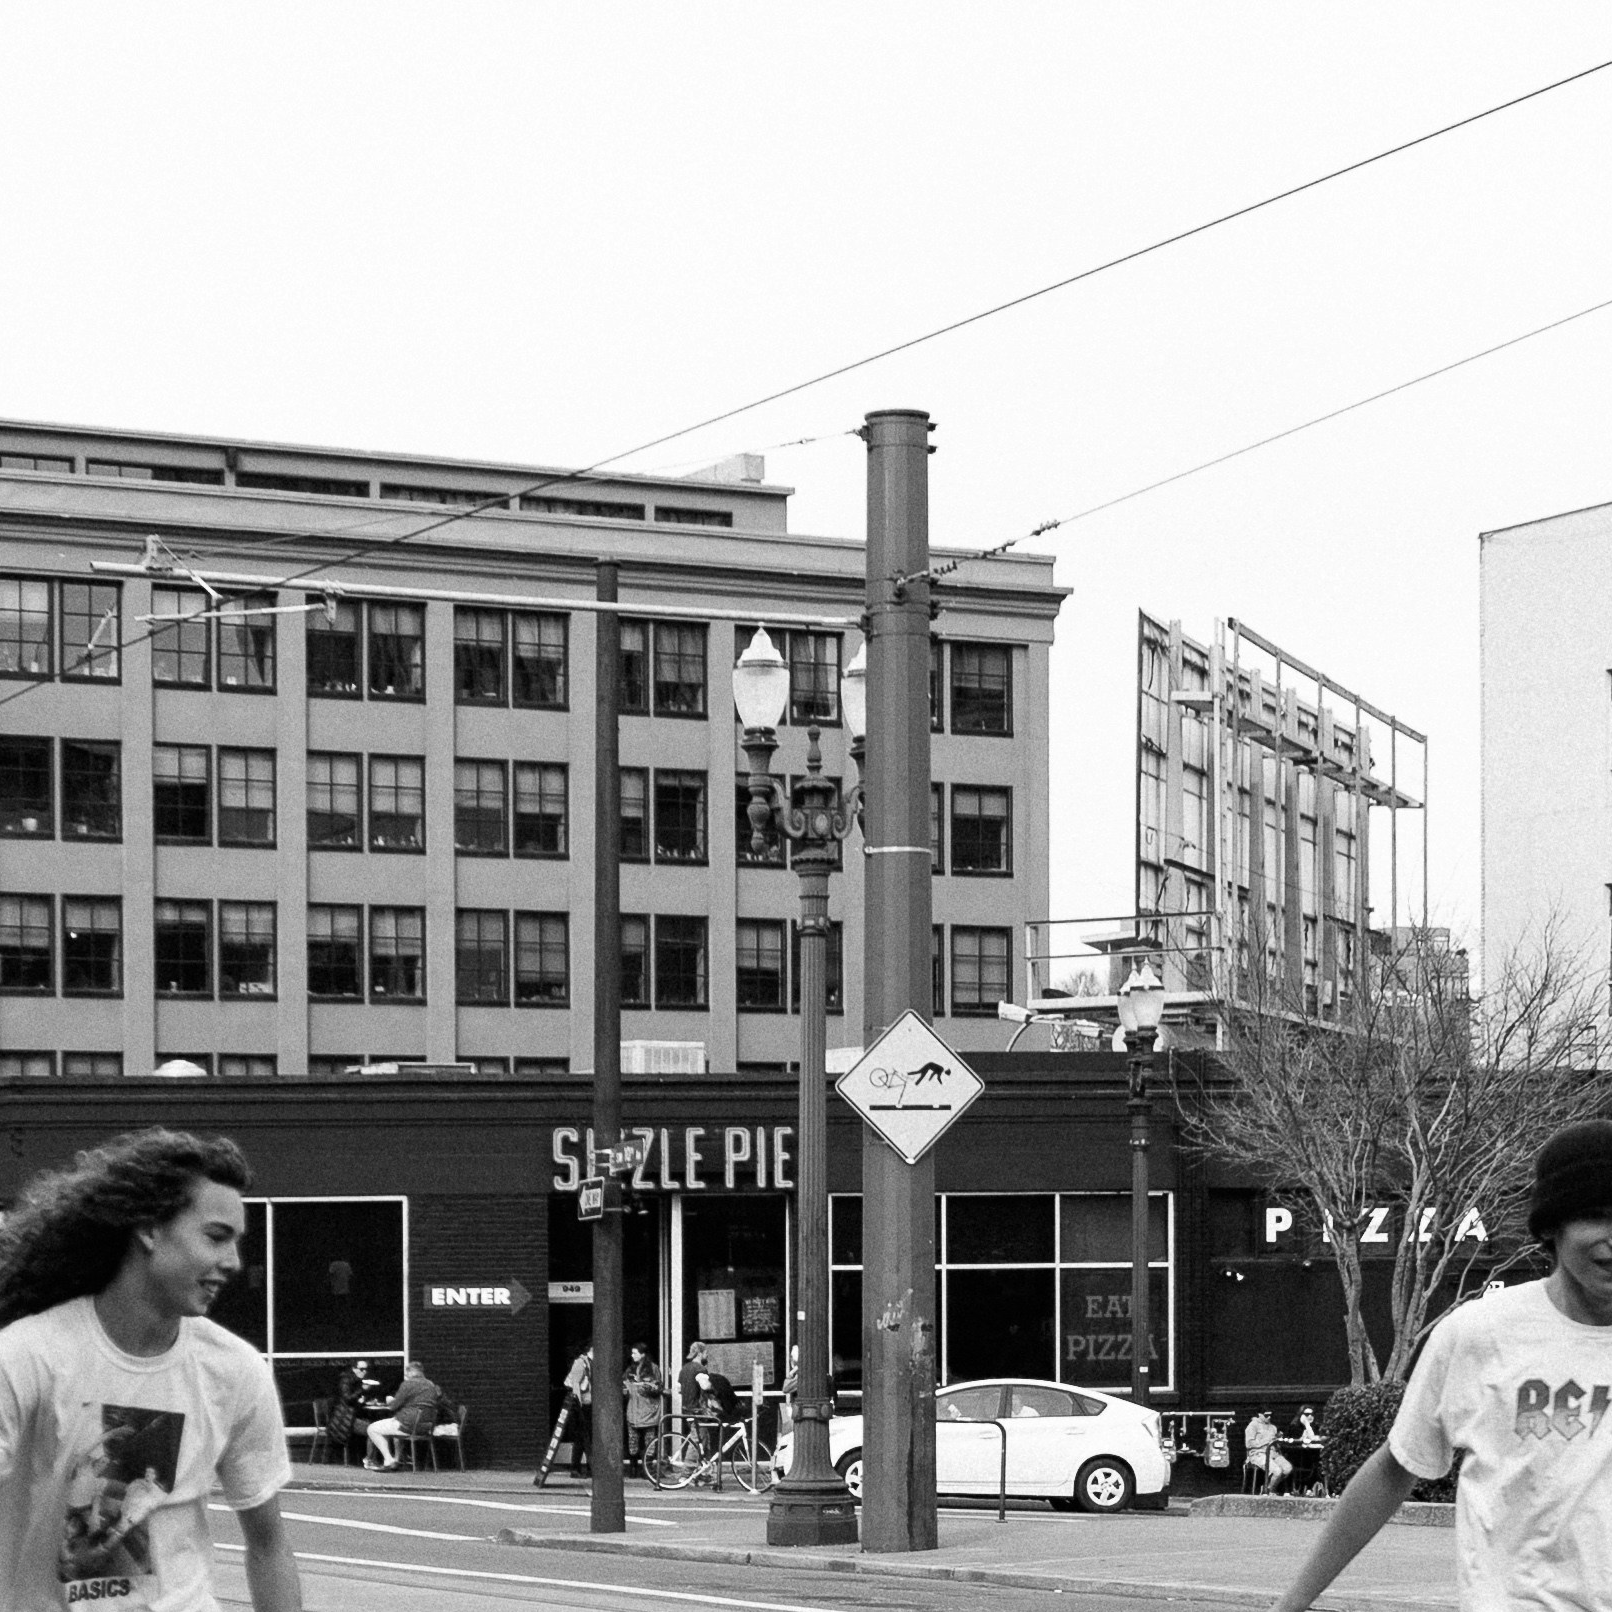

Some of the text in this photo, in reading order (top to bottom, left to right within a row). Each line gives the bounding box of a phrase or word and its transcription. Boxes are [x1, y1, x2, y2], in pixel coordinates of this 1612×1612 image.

[553, 1127, 794, 1190] SIZLE PIE
[431, 1287, 512, 1305] ENTER
[68, 1577, 131, 1603] BASICS
